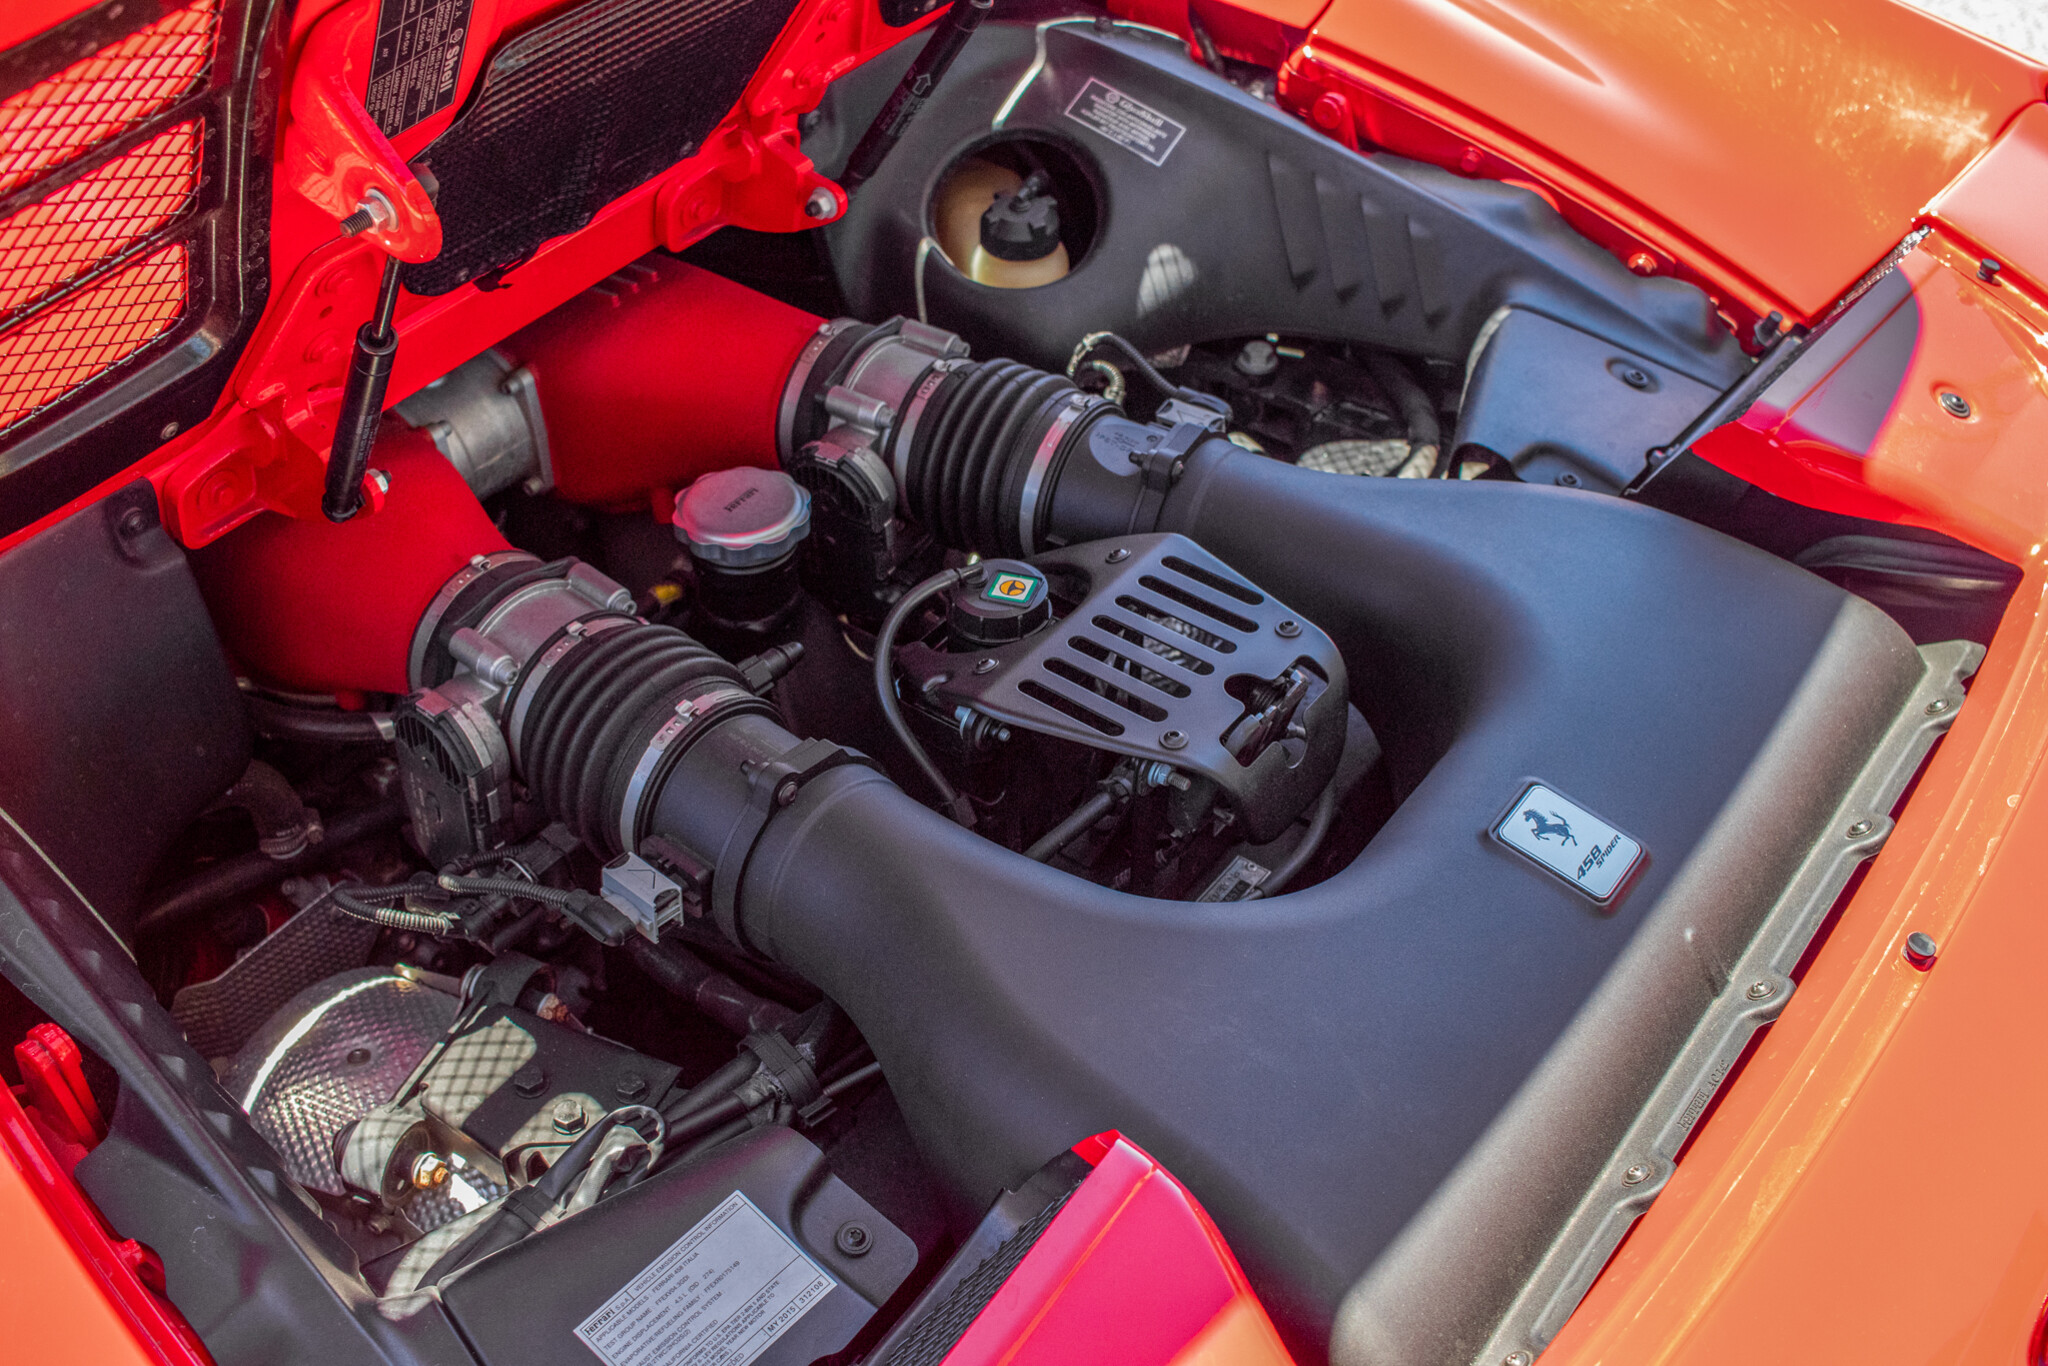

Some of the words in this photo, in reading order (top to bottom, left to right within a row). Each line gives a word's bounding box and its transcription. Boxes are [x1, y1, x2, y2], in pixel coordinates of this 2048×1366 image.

[440, 45, 460, 93] Shell
[1577, 844, 1602, 881] 458
[1595, 834, 1622, 868] SPIDER
[633, 1271, 657, 1292] VEHICLE
[655, 1250, 681, 1273] EMISSION
[679, 1229, 705, 1252] CONTROL
[703, 1201, 738, 1231] INFORMATION
[594, 1313, 627, 1342] APPLICABLE
[625, 1294, 649, 1315] MODELS
[651, 1271, 676, 1293] FERRARI
[673, 1264, 684, 1274] 458
[682, 1251, 699, 1266] ITALIA
[681, 1294, 701, 1312] FAMILY
[797, 1280, 824, 1303] 312108
[583, 1307, 615, 1335] Ferrari
[603, 1337, 619, 1350] TEST
[616, 1320, 637, 1339] GROUP
[635, 1307, 652, 1322] NAME
[611, 1339, 633, 1359] ENGINE
[630, 1305, 672, 1341] DISPLACEMENT
[651, 1330, 678, 1354] EMISSION
[676, 1309, 703, 1332] CONTROL
[700, 1291, 723, 1310] SYSTEM
[664, 1341, 693, 1366] ALIFORNIA
[690, 1318, 719, 1344] CERTIFIED
[682, 1346, 707, 1366] ONFORMS
[705, 1339, 713, 1347] TO
[720, 1323, 731, 1333] EPA
[729, 1314, 741, 1325] TIER
[754, 1292, 766, 1302] AND
[764, 1279, 780, 1293] STATE
[709, 1322, 743, 1351] REGULATIONS
[740, 1298, 769, 1324] APPLICABLE
[766, 1292, 775, 1300] TO
[709, 1344, 727, 1360] MODEL
[725, 1333, 739, 1346] YEAR
[737, 1324, 749, 1335] NEW
[747, 1309, 766, 1326] MOTOR
[766, 1320, 780, 1332] MY
[777, 1305, 796, 1322] 2015
